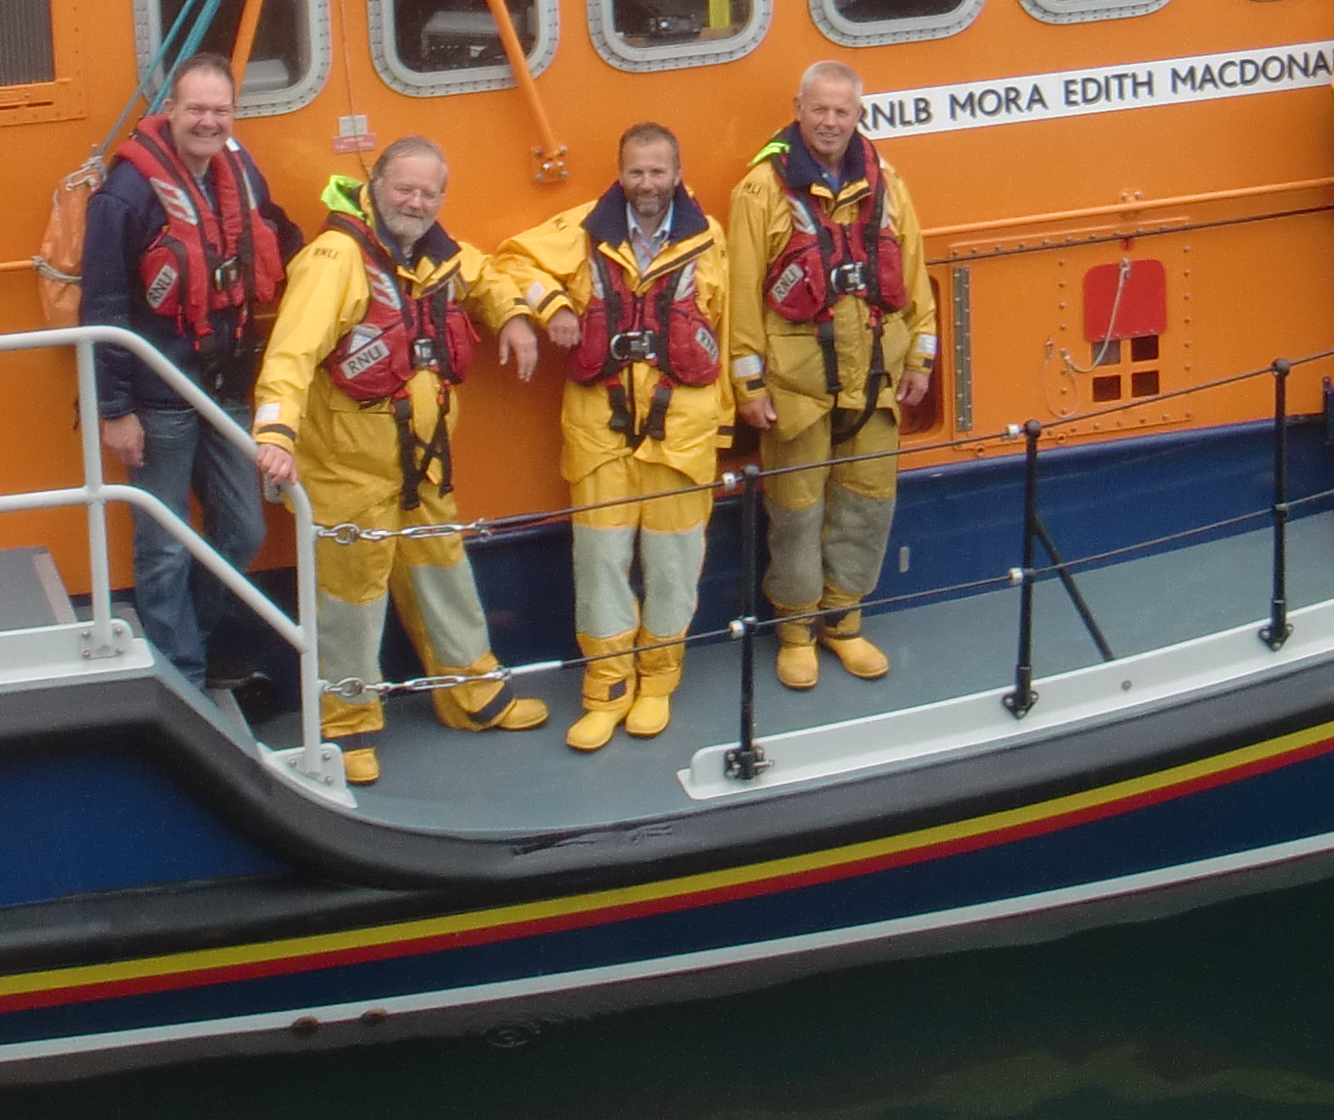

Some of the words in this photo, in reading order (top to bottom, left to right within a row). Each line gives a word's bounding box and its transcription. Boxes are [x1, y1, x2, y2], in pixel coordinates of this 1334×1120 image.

[948, 83, 1050, 126] MORA
[1062, 69, 1155, 109] EDITH
[147, 271, 173, 302] RNLI
[773, 268, 798, 299] RNLI
[346, 344, 383, 375] RNLI
